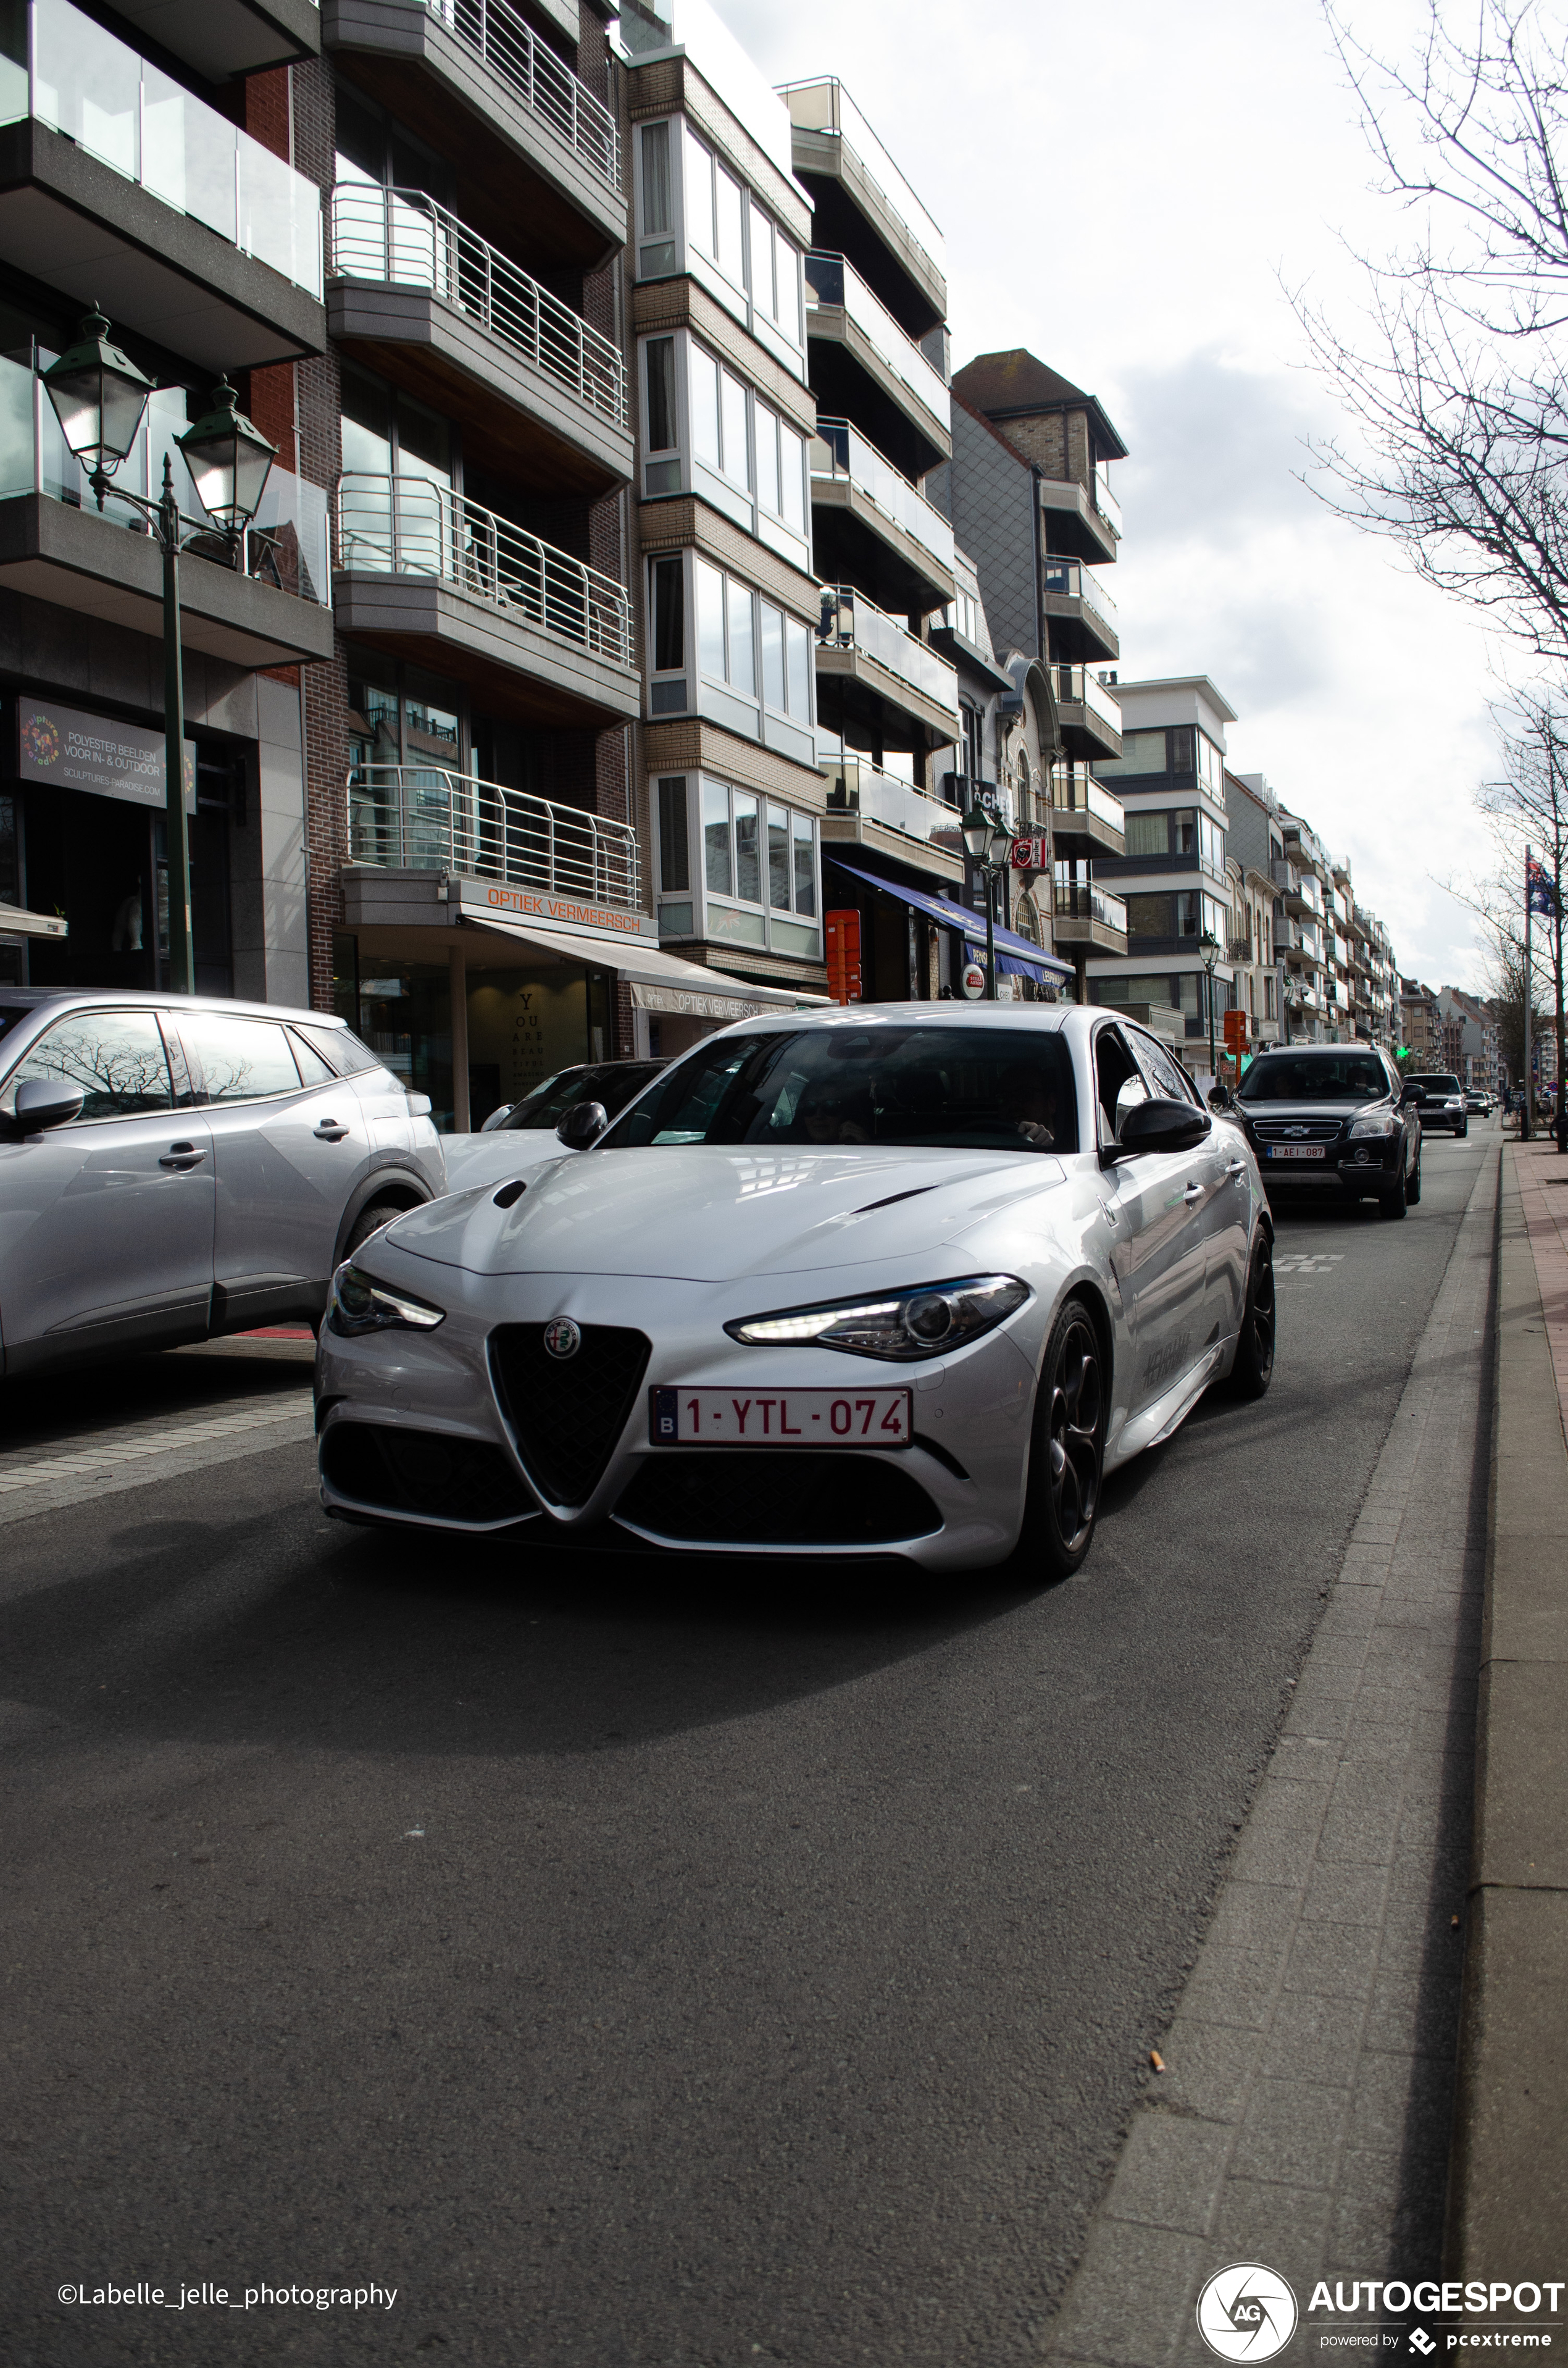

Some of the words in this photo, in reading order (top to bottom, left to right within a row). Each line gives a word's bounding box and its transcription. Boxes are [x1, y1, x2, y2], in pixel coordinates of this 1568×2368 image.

[69, 732, 117, 755] POLYESTER
[118, 743, 156, 764] BEELDEN
[64, 744, 91, 761] VOOR
[93, 751, 105, 764] IN-
[106, 756, 114, 766] &
[115, 757, 160, 777] OUTDOOR
[64, 767, 161, 797] SCULPTURES-PARADISE.COM
[488, 889, 543, 914] OPTIEK
[548, 900, 640, 932] VERMEERSCH
[520, 994, 533, 1010] Y
[999, 990, 1011, 1000] CHEO
[648, 994, 663, 1005] OPTIEK
[678, 994, 708, 1014] OPTIEK
[709, 998, 759, 1019] VERMEERSCH
[516, 1016, 538, 1027] OU
[512, 1032, 542, 1042] ARE
[512, 1047, 543, 1055] BEAU
[1273, 1146, 1323, 1156] 1-AEI-087
[546, 1323, 557, 1337] ALFA
[560, 1321, 577, 1340] ROMEO
[660, 1417, 674, 1433] B
[686, 1399, 902, 1435] 1-YTL-074
